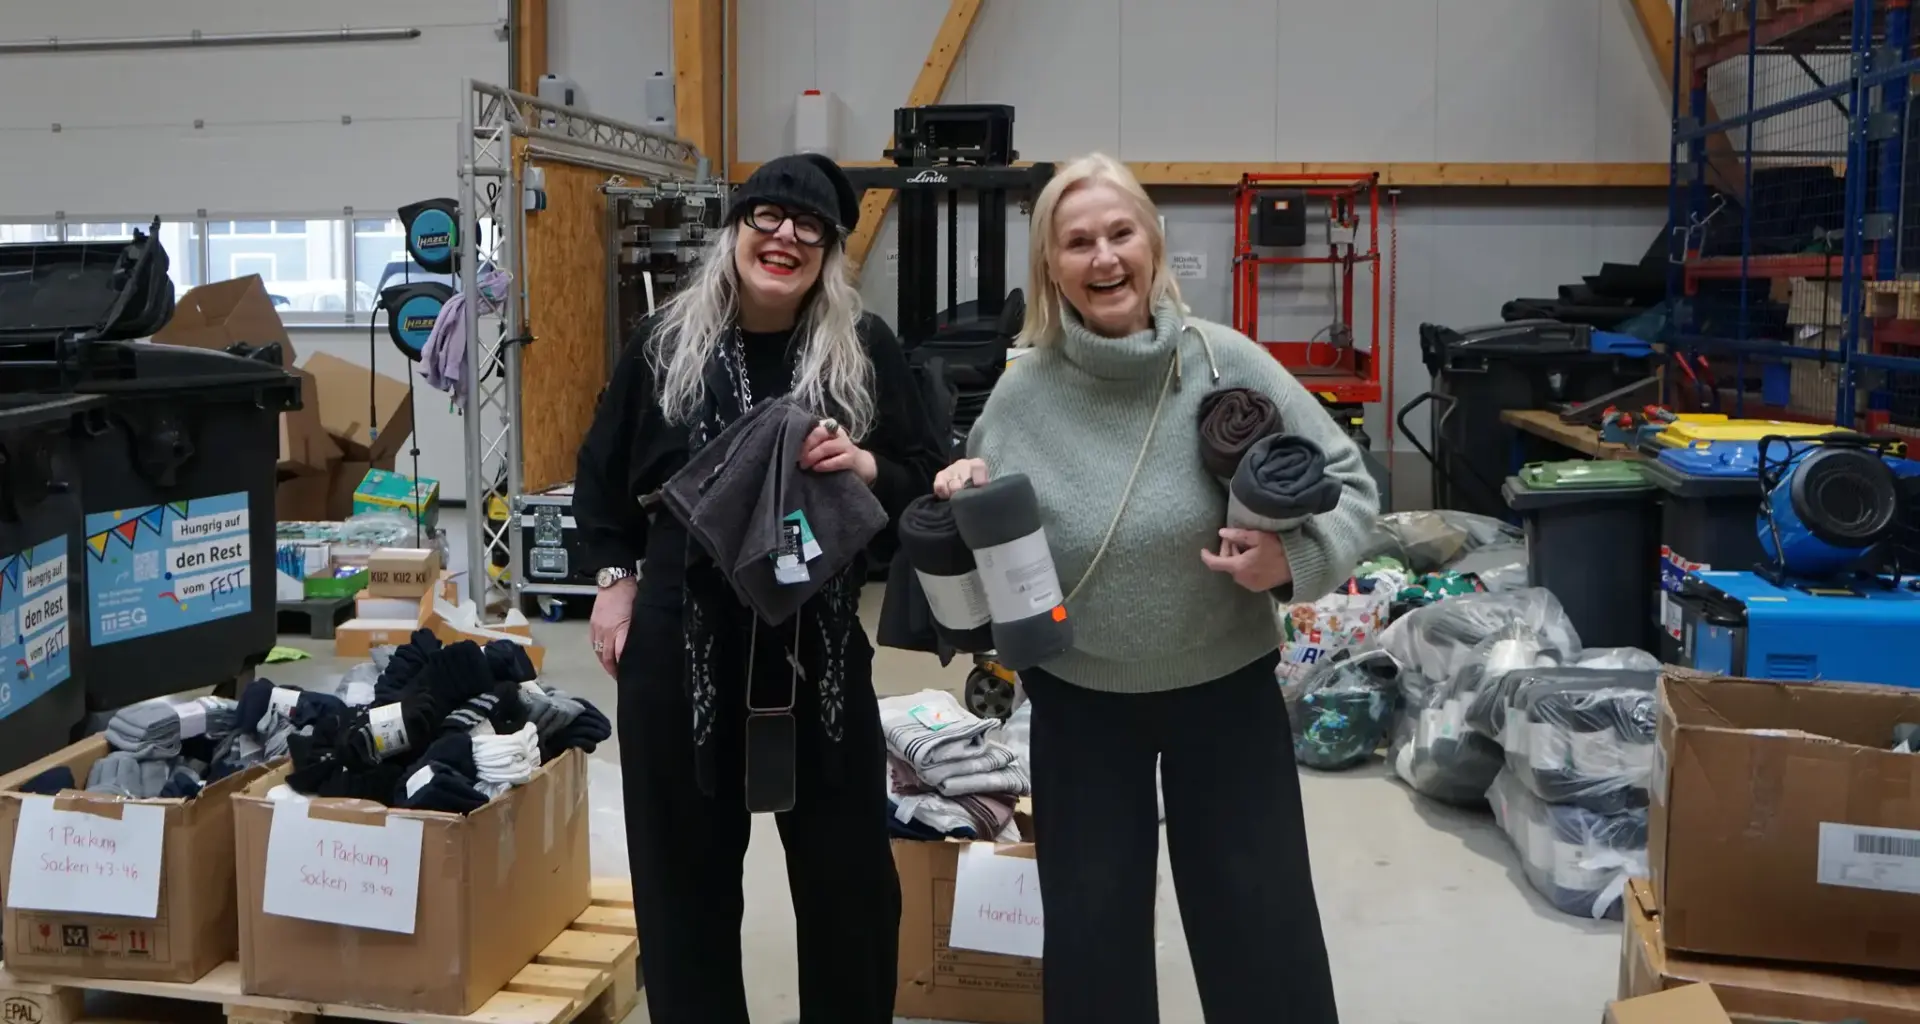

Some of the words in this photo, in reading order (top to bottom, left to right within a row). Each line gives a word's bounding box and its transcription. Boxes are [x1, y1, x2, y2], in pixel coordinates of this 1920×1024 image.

[906, 170, 948, 183] Linde
[420, 234, 449, 246] HAZET
[180, 519, 222, 536] Hungrig
[224, 515, 241, 528] auf
[176, 552, 205, 569] den
[209, 543, 242, 562] Rest
[27, 567, 52, 589] Hungrig
[52, 561, 63, 577] auf
[183, 584, 205, 595] vom
[209, 568, 245, 602] FEST
[25, 609, 42, 630] den
[44, 595, 64, 618] Rest
[101, 607, 147, 632] MEG
[30, 645, 44, 661] vom
[45, 626, 66, 668] FEST
[48, 826, 55, 843] 1
[61, 826, 117, 854] Packung
[40, 853, 90, 874] Socken
[316, 839, 324, 857] 1
[332, 840, 389, 875] Packung
[300, 865, 347, 891] Socken
[1014, 872, 1024, 895] 1
[5, 1003, 36, 1022] EPAL
